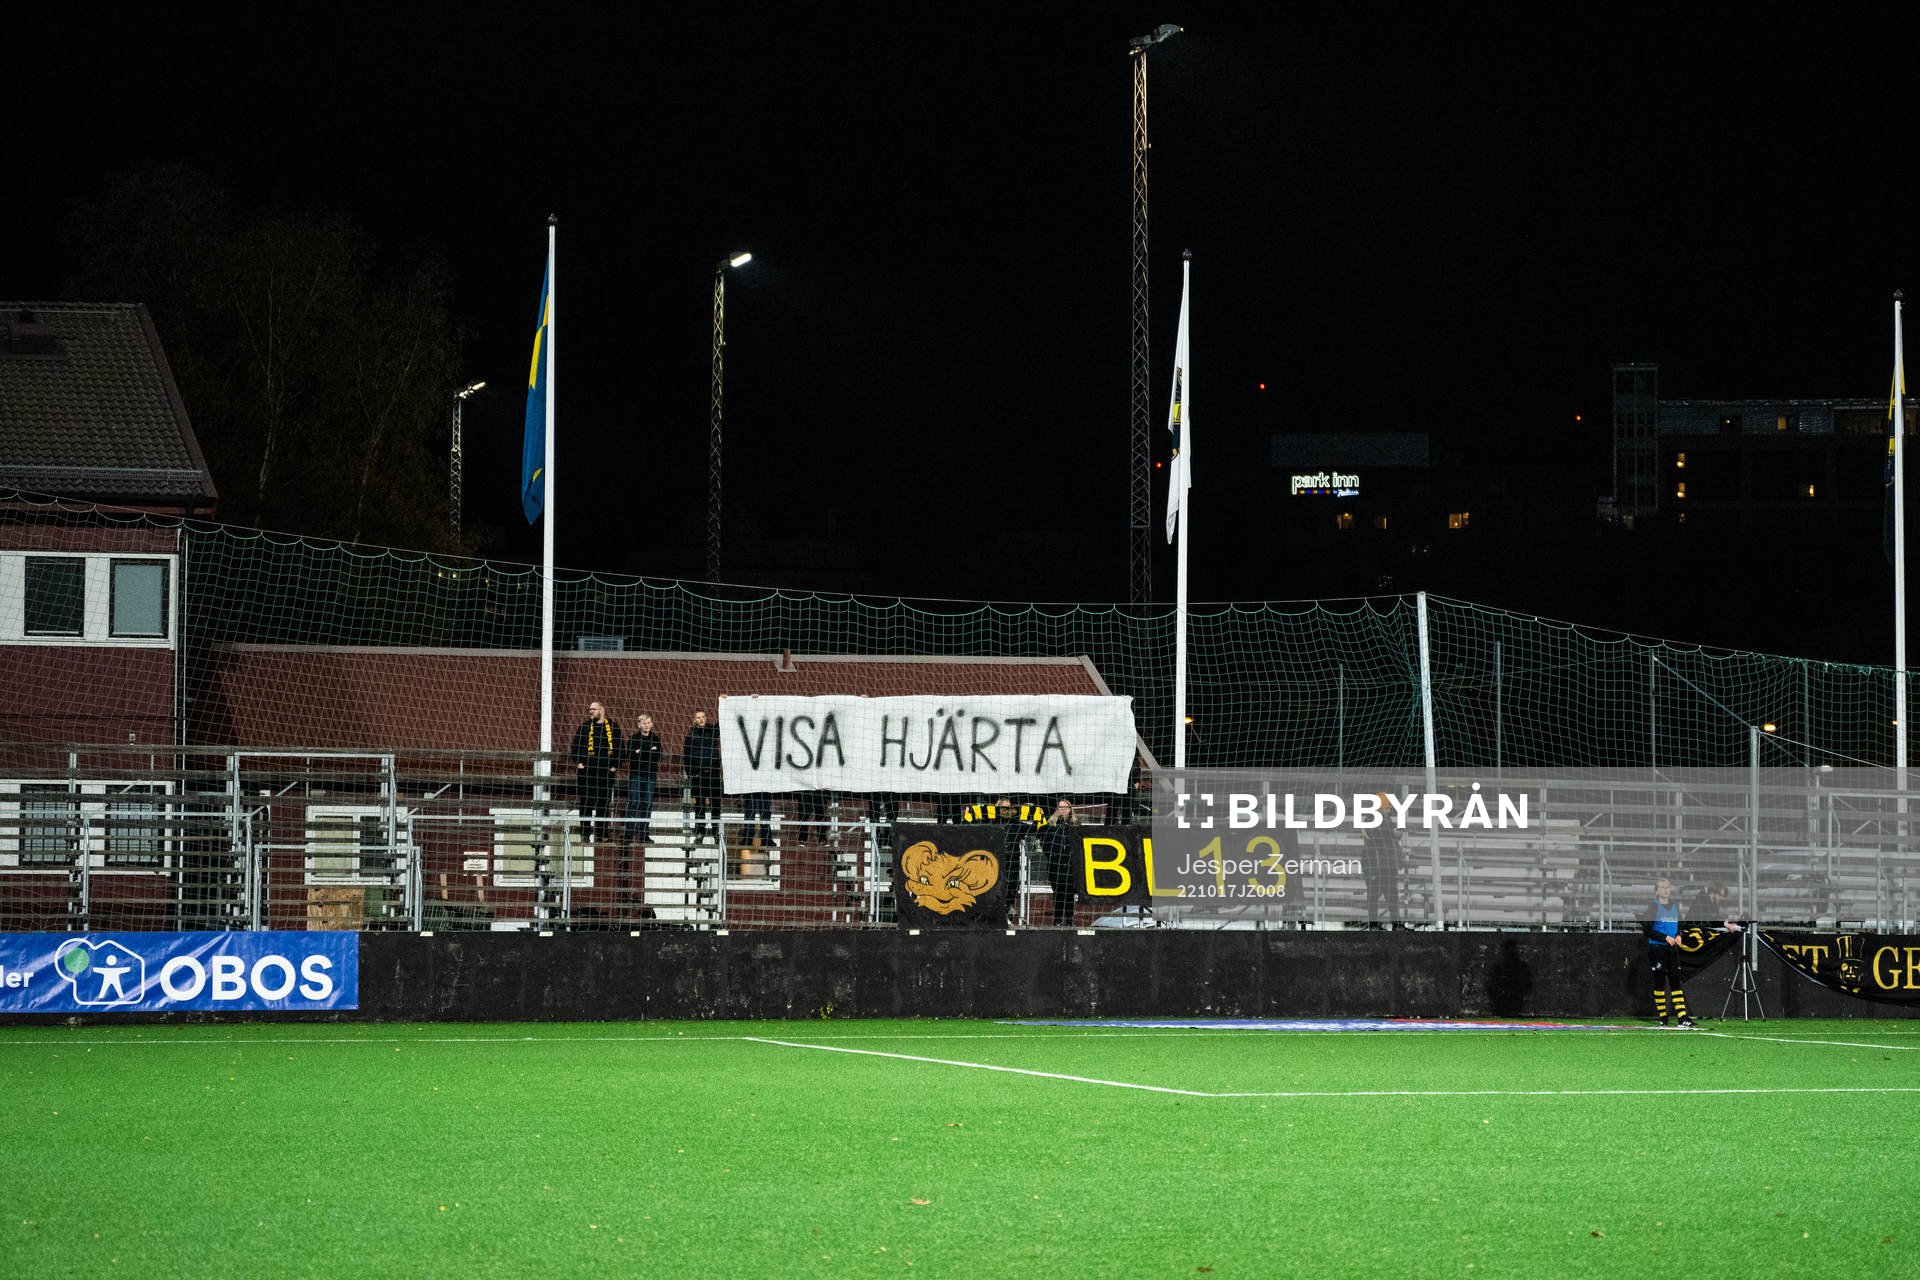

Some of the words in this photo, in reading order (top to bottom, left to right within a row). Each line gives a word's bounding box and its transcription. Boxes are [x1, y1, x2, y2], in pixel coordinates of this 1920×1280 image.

[1292, 472, 1330, 495] park
[1332, 472, 1360, 488] inn
[738, 712, 845, 770] VISA
[880, 707, 1073, 776] HJÄRTA
[1083, 836, 1180, 897] BL
[1198, 835, 1287, 897] 13
[160, 955, 333, 1001] OBOS
